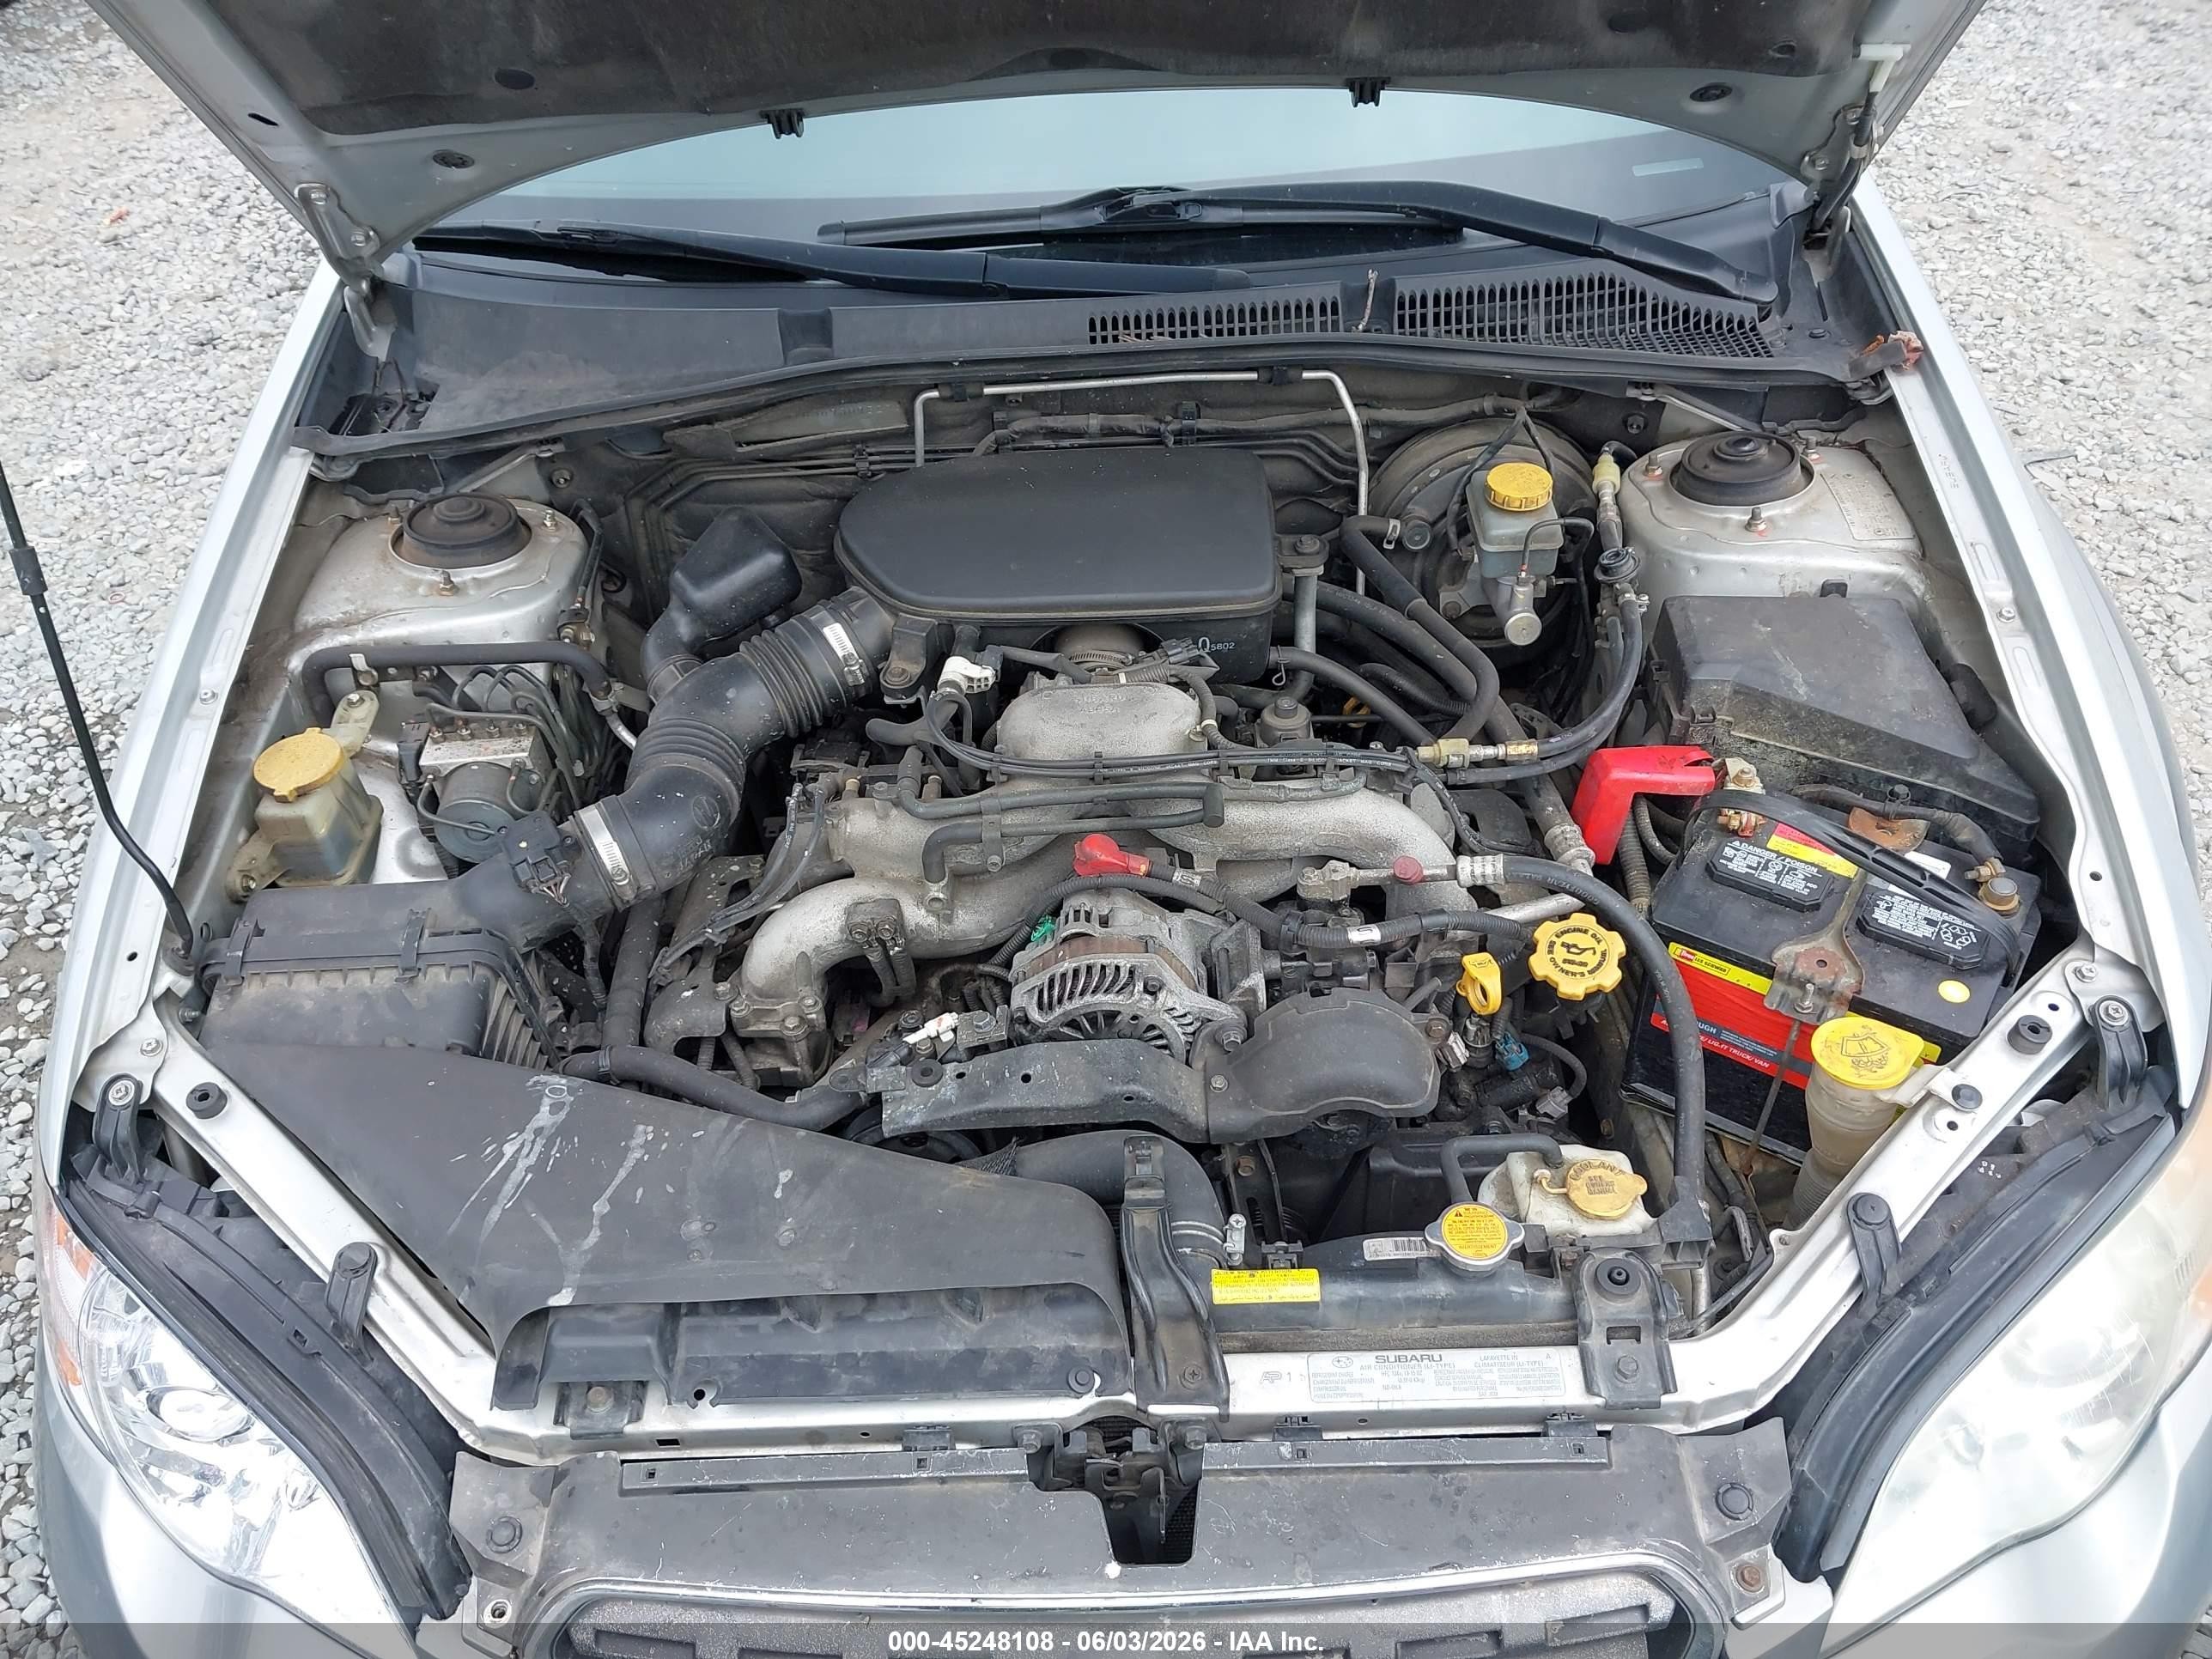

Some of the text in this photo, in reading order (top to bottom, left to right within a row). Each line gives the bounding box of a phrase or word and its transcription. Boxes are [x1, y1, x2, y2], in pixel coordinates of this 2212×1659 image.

[1741, 842, 1778, 859] DANGER
[1784, 858, 1819, 873] POISON
[1547, 876, 1601, 906] GOODYEAR
[1554, 927, 1604, 946] ENGINE OIL
[1547, 939, 1557, 956] SEE
[1754, 1057, 1771, 1068] VAN
[1569, 1161, 1626, 1181] COOLANT
[1375, 1353, 1443, 1364] SUBARU
